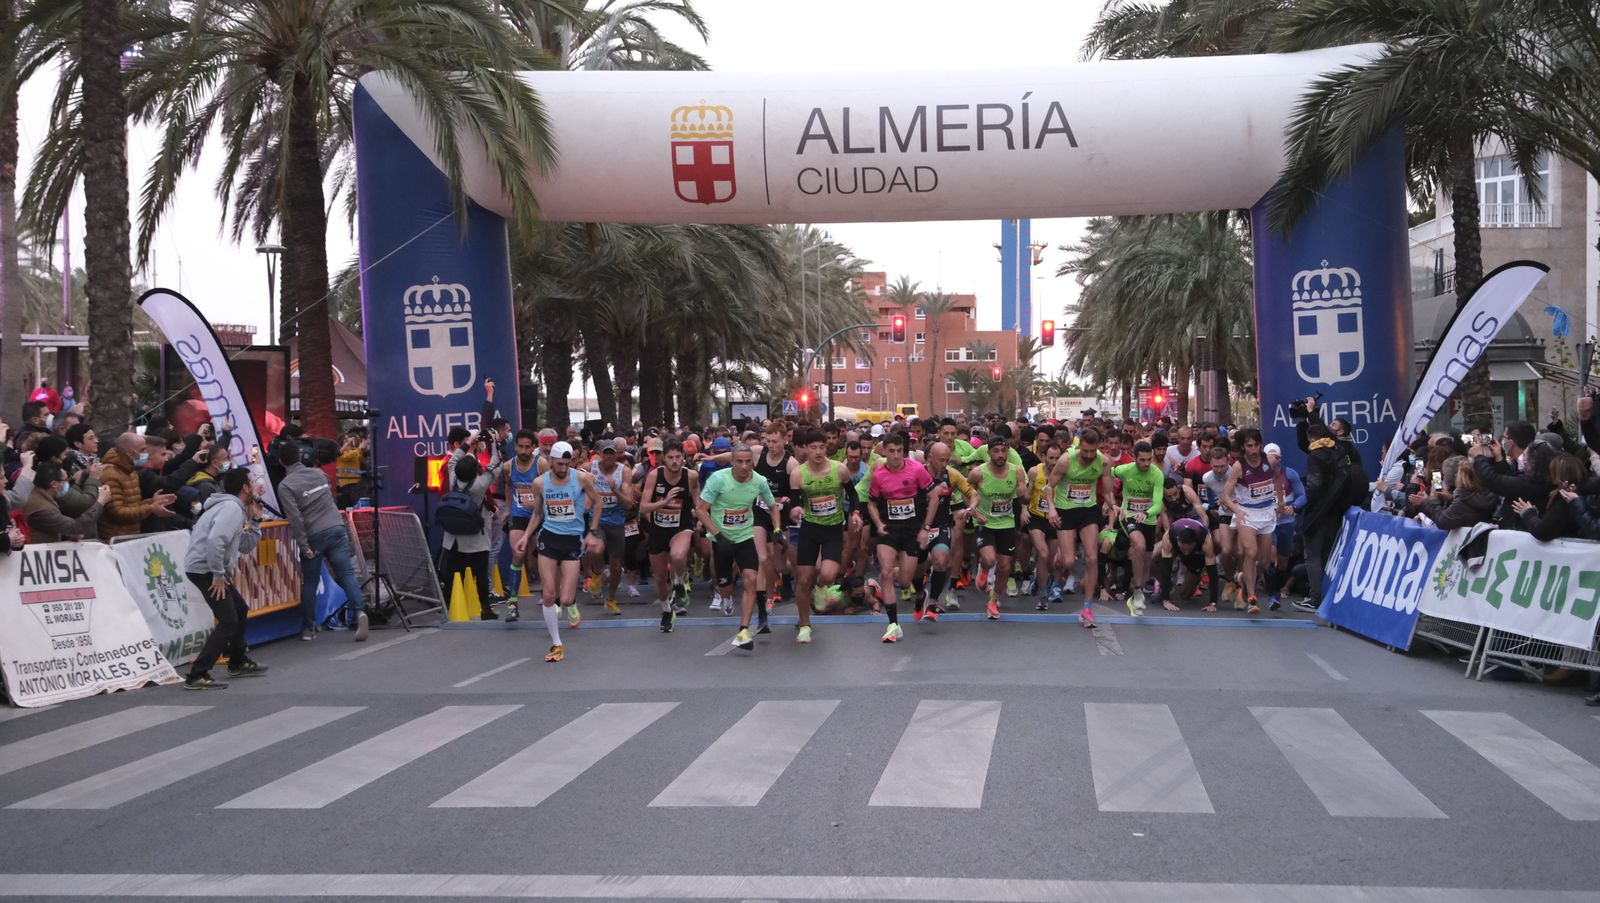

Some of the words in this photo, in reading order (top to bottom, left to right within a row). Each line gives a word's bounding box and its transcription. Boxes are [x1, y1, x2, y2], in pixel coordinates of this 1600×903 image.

[795, 91, 1079, 155] ALMERÍA
[796, 165, 939, 196] CIUDAD
[545, 490, 569, 500] nerja
[551, 505, 569, 514] 587
[893, 505, 911, 514] 314
[658, 514, 675, 522] 541
[728, 514, 745, 523] 521
[19, 549, 90, 586] AMSA
[1332, 528, 1430, 616] joma
[45, 615, 54, 625] EL
[53, 612, 85, 624] MORALES
[51, 637, 76, 650] Desde
[75, 634, 93, 647] 1950
[12, 656, 68, 676] Transportes
[69, 657, 75, 672] y
[76, 637, 156, 667] Contenedores
[19, 675, 68, 697] ANTONIO
